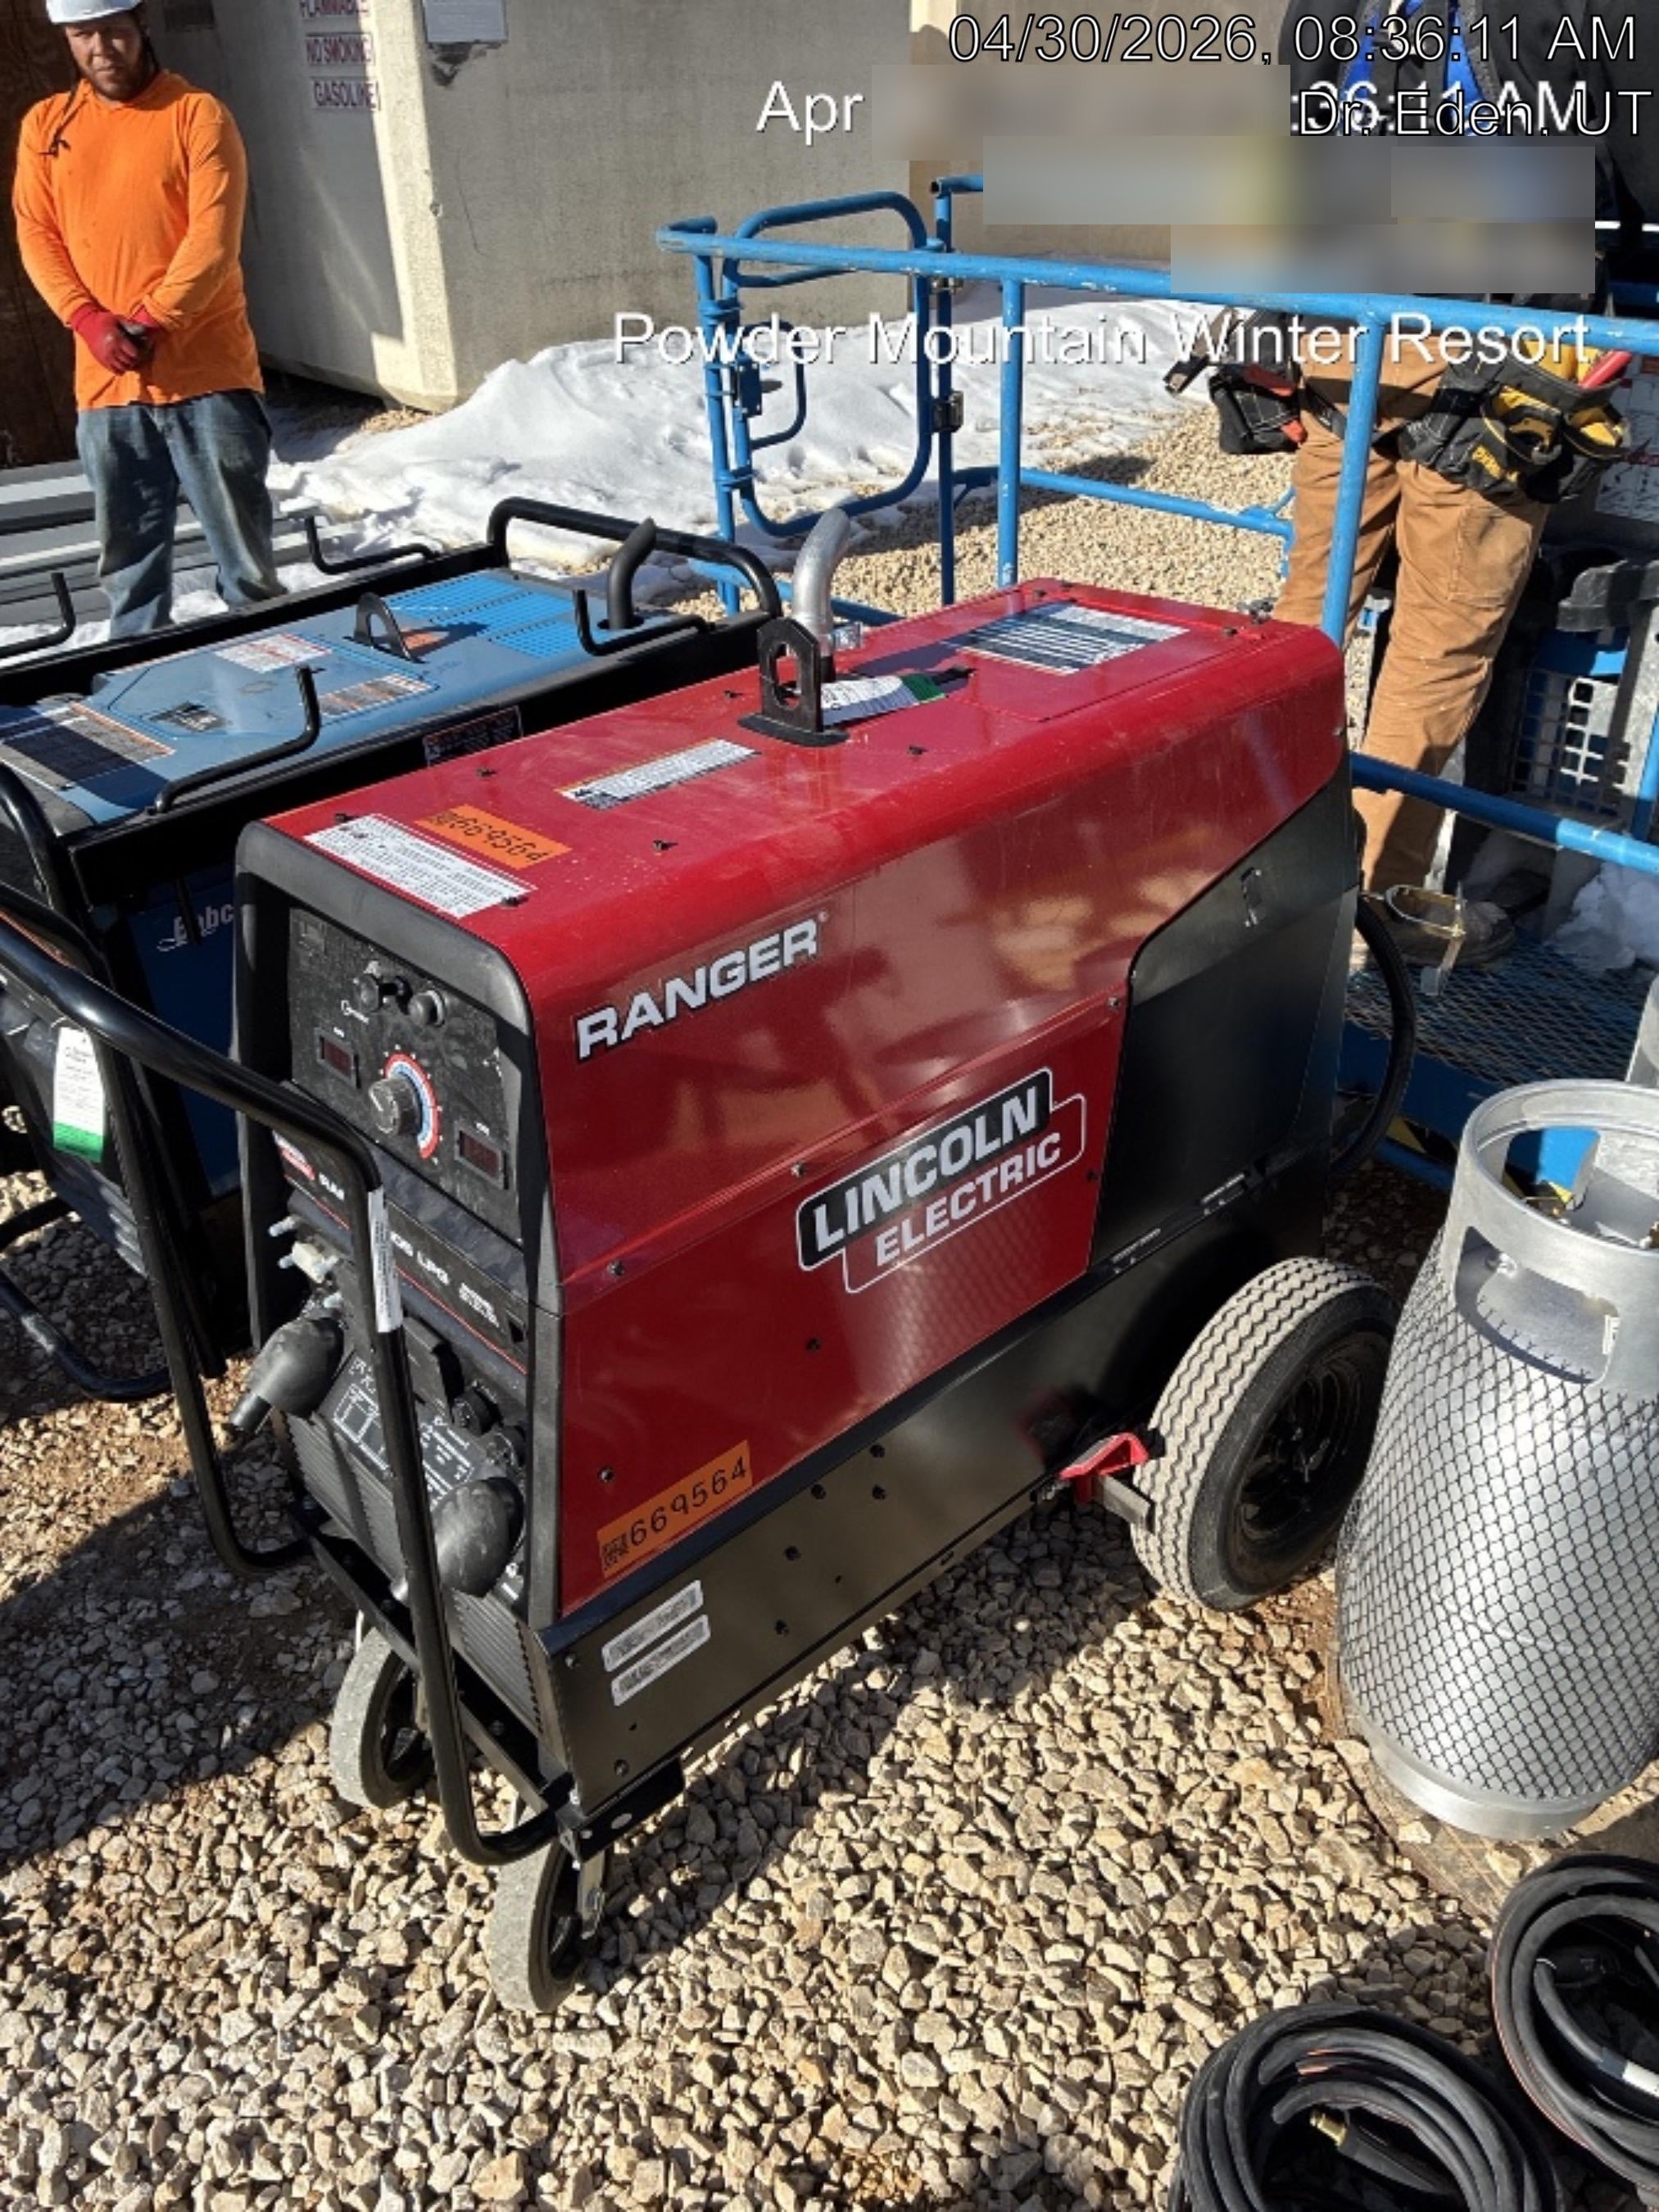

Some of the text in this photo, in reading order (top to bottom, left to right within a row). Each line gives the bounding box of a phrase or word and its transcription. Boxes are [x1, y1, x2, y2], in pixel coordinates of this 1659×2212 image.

[577, 919, 819, 1061] RANGER
[811, 1086, 1039, 1252] LINCOLN
[873, 1133, 1063, 1267] ELECTRIC
[630, 1456, 747, 1546] 669564
